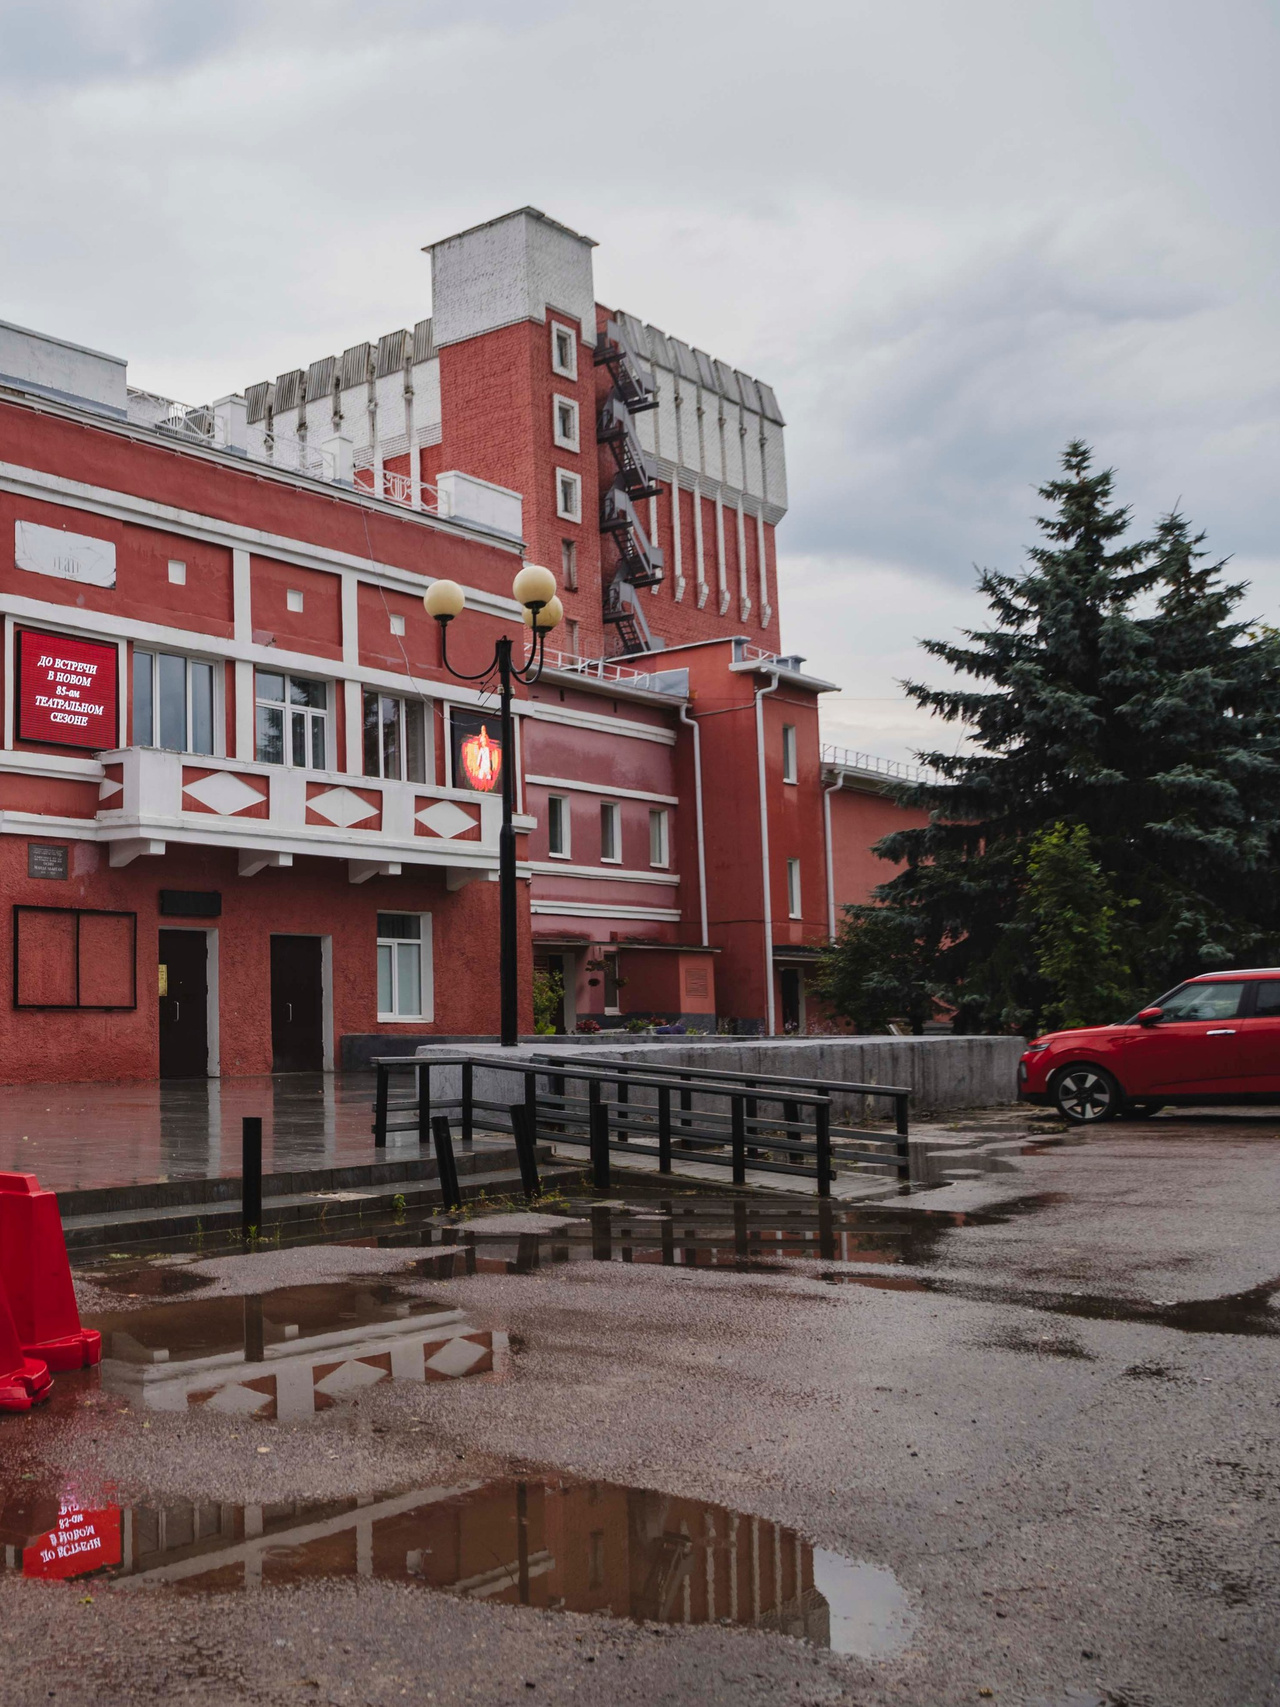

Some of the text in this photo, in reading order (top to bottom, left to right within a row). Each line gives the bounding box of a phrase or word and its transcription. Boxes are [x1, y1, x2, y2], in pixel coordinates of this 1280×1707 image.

[37, 655, 98, 675] ДО ВСТРЕЧИ
[47, 670, 92, 687] В НОВОМ
[35, 695, 104, 716] ТЕАТРАЛЬНОМ
[50, 711, 89, 727] СЕЗОНЕ
